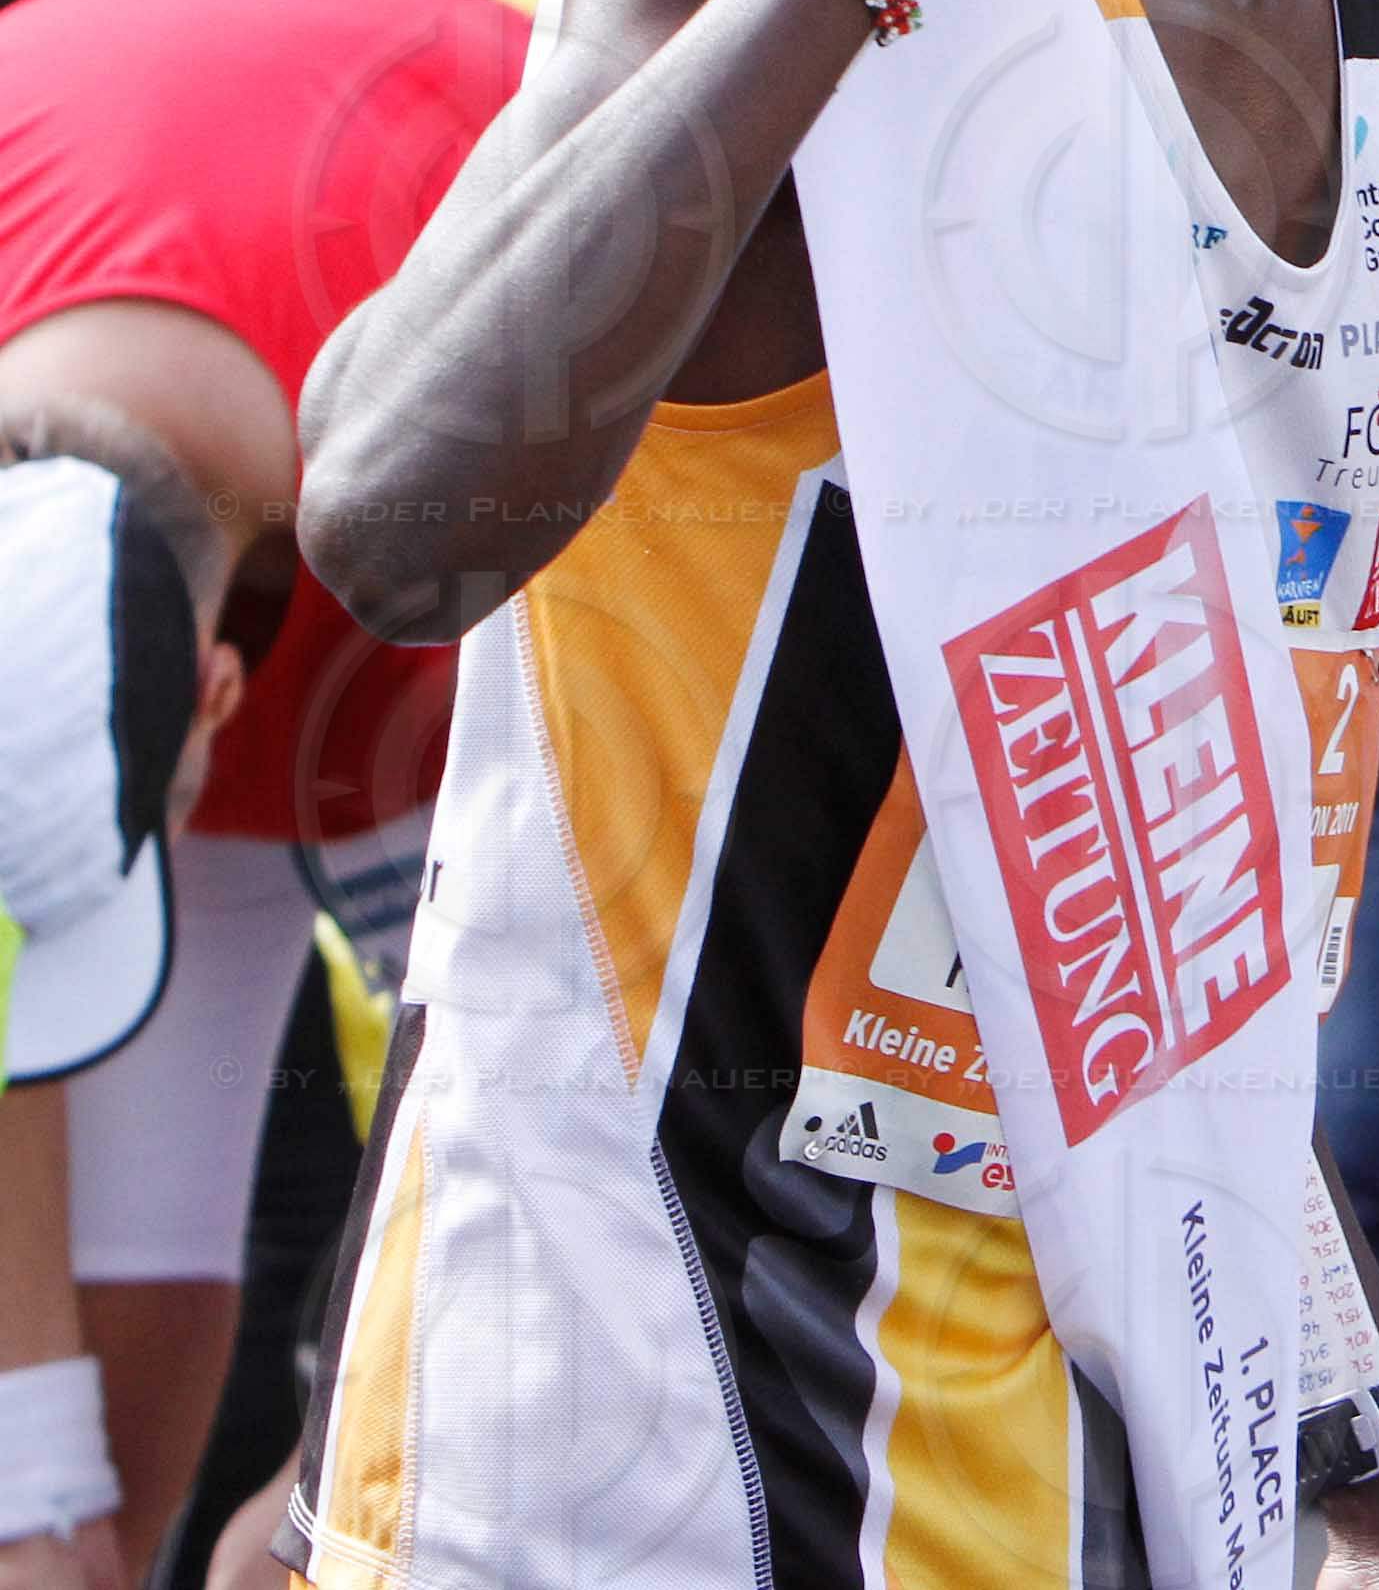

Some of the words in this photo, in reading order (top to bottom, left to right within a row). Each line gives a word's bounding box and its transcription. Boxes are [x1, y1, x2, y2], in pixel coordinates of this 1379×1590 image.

[1318, 663, 1360, 776] 2
[1089, 541, 1270, 1038] KLEINE
[979, 619, 1156, 1109] ZEITUNG
[842, 1009, 957, 1074] Kleine
[824, 1133, 888, 1162] adidas
[1181, 1200, 1215, 1346] Kleine
[1203, 1347, 1236, 1523] Zeitung
[1226, 1522, 1246, 1590] Ma
[1240, 1336, 1269, 1376] 1.
[1243, 1377, 1285, 1538] PLACE
